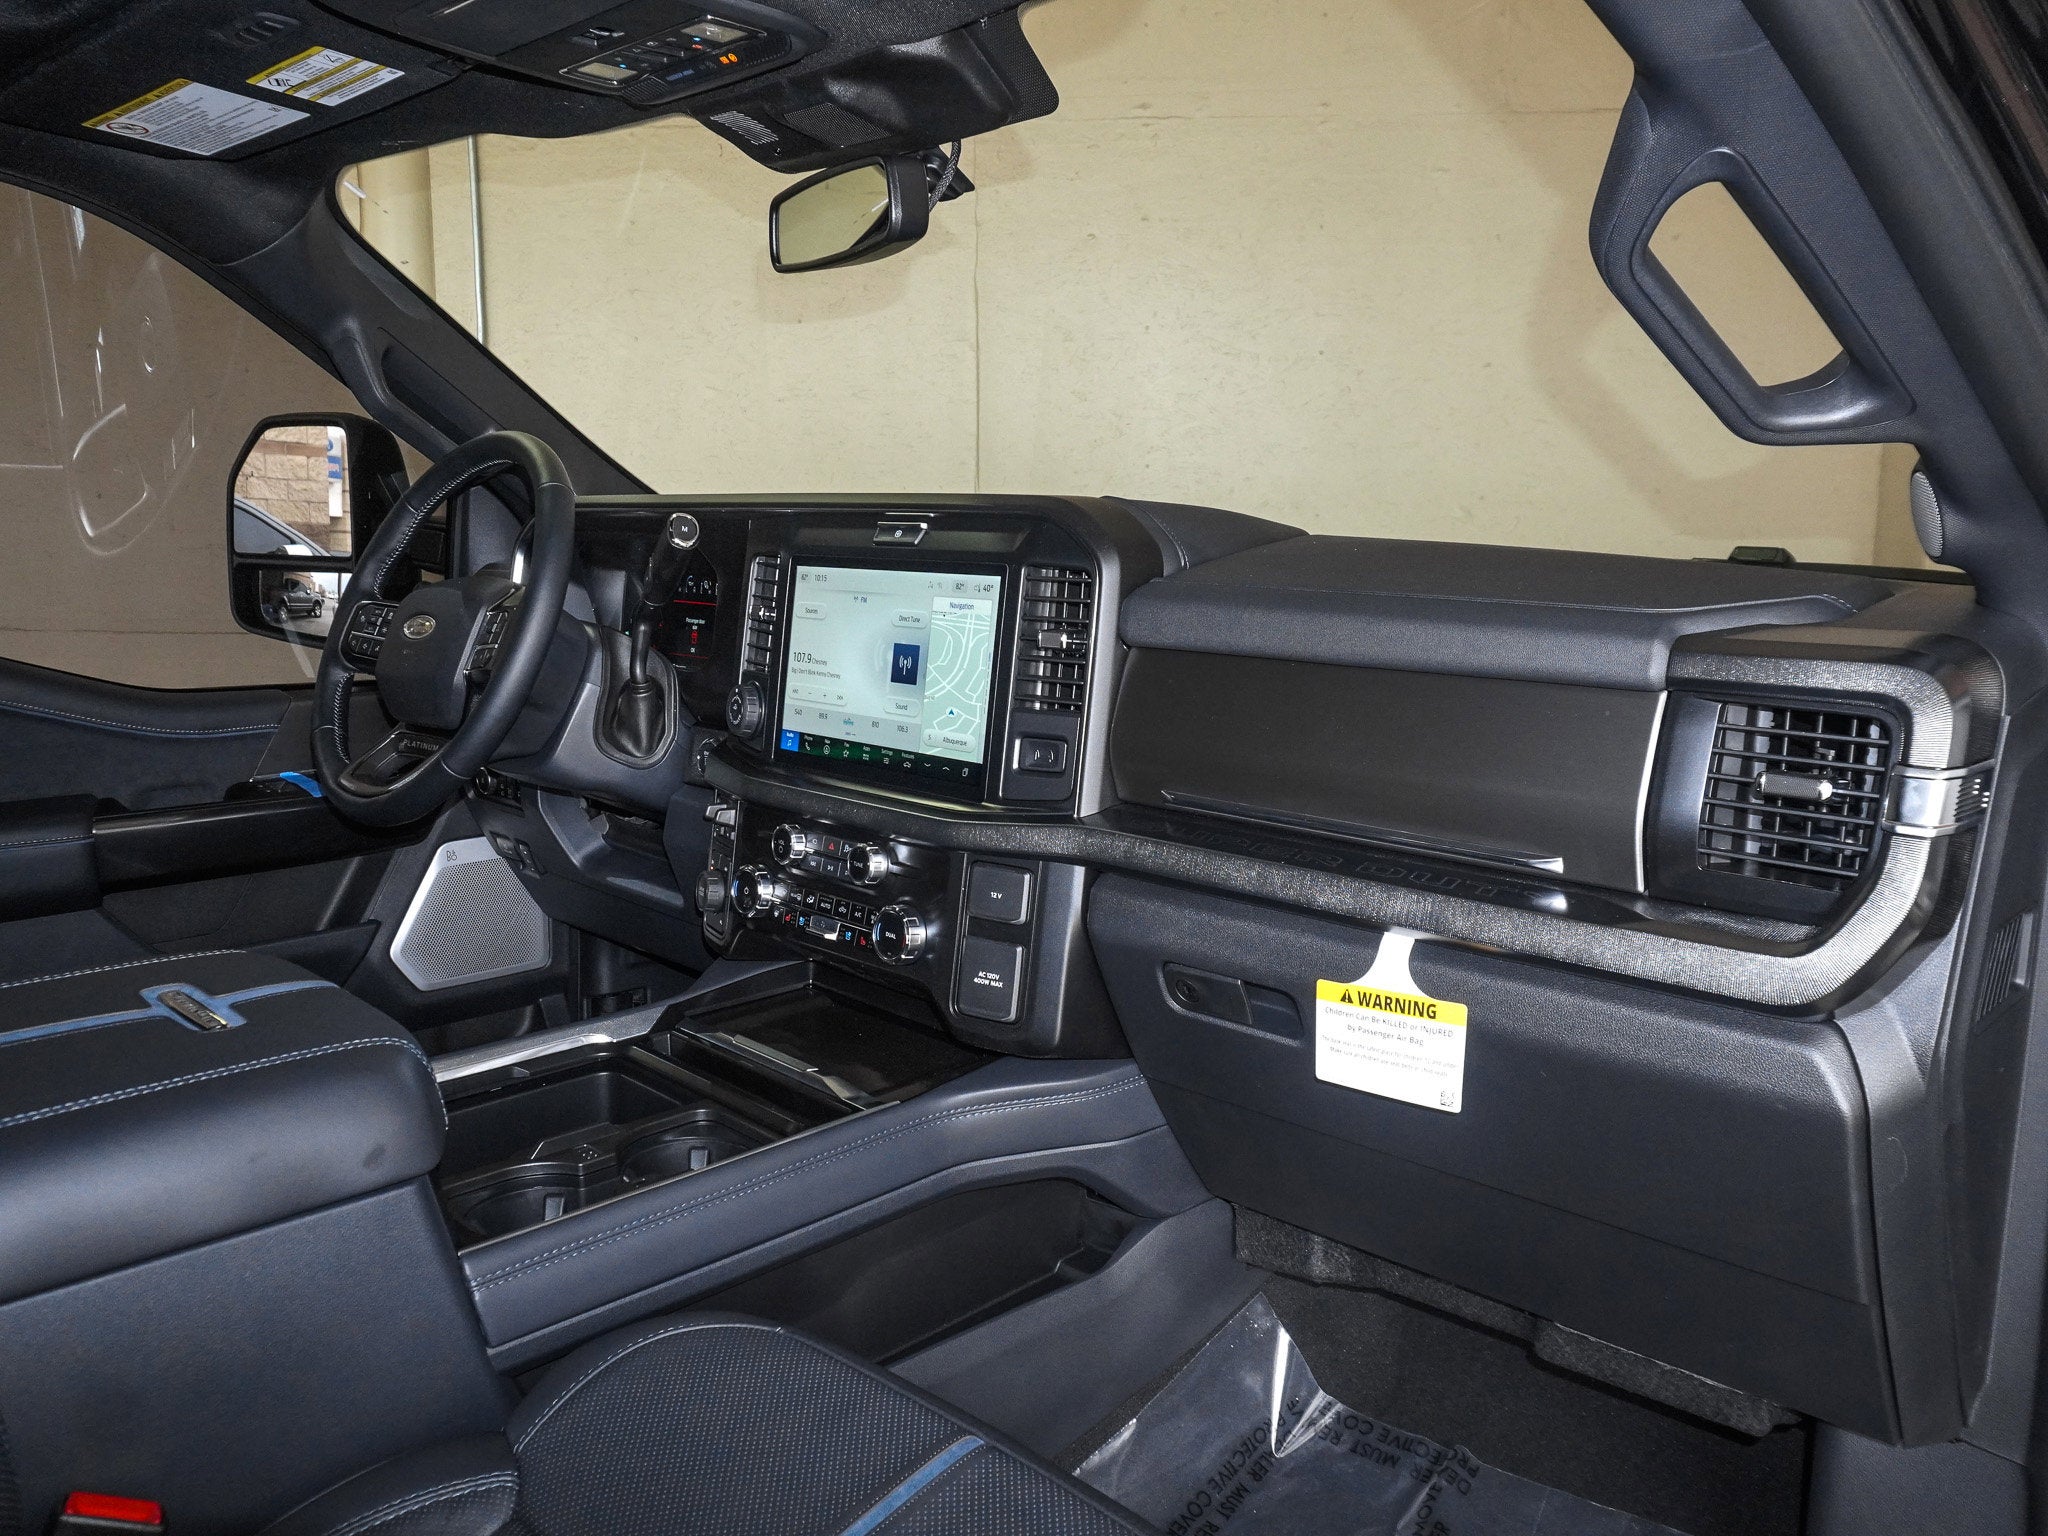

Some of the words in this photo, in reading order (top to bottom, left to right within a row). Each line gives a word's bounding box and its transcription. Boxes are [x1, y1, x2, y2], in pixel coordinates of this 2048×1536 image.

[814, 574, 828, 582] 10:15
[949, 601, 975, 611] Navigation
[793, 651, 812, 664] 107.9
[895, 703, 908, 711] Sound
[820, 902, 831, 910] AUTO
[854, 911, 862, 919] A/C
[885, 931, 896, 940] DUAL
[990, 979, 1003, 988] MAX
[1357, 990, 1437, 1020] WARNING
[1325, 1006, 1354, 1019] Children
[1355, 1012, 1369, 1021] Can
[1371, 1015, 1380, 1024] Be
[1382, 1018, 1408, 1029] KILLED
[1420, 1025, 1454, 1038] INJURED
[1358, 1026, 1394, 1040] Passenger
[1409, 1036, 1424, 1046] Bag
[1350, 1440, 1400, 1468] MUST
[1377, 1427, 1480, 1479] PROECTIVE
[1216, 1482, 1252, 1520] MUST
